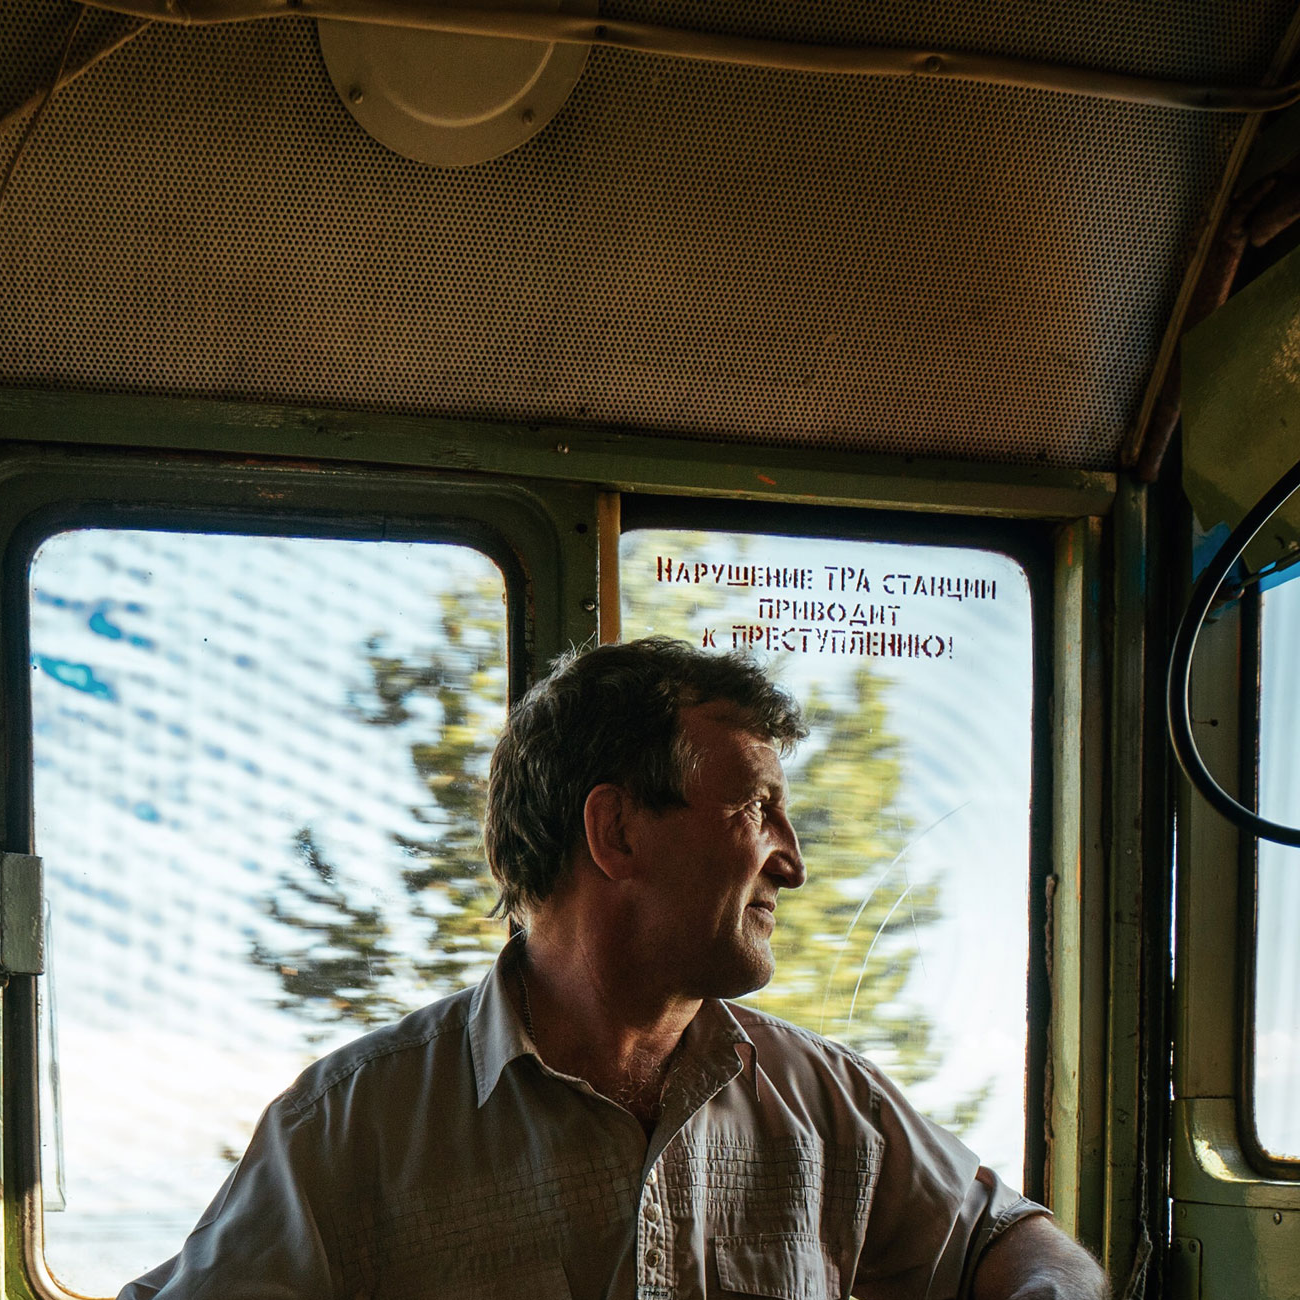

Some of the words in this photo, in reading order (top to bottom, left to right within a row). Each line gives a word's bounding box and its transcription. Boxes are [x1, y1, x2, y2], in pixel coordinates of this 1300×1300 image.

[656, 556, 813, 590] НАРУШЕНИЕ
[824, 566, 871, 593] ТРА
[882, 574, 998, 602] СТАНЦИИ
[758, 598, 901, 627] ПРИВОДИТ
[702, 627, 717, 649] К
[731, 625, 955, 659] ПРЕСТУПЛЕНИЮ!
